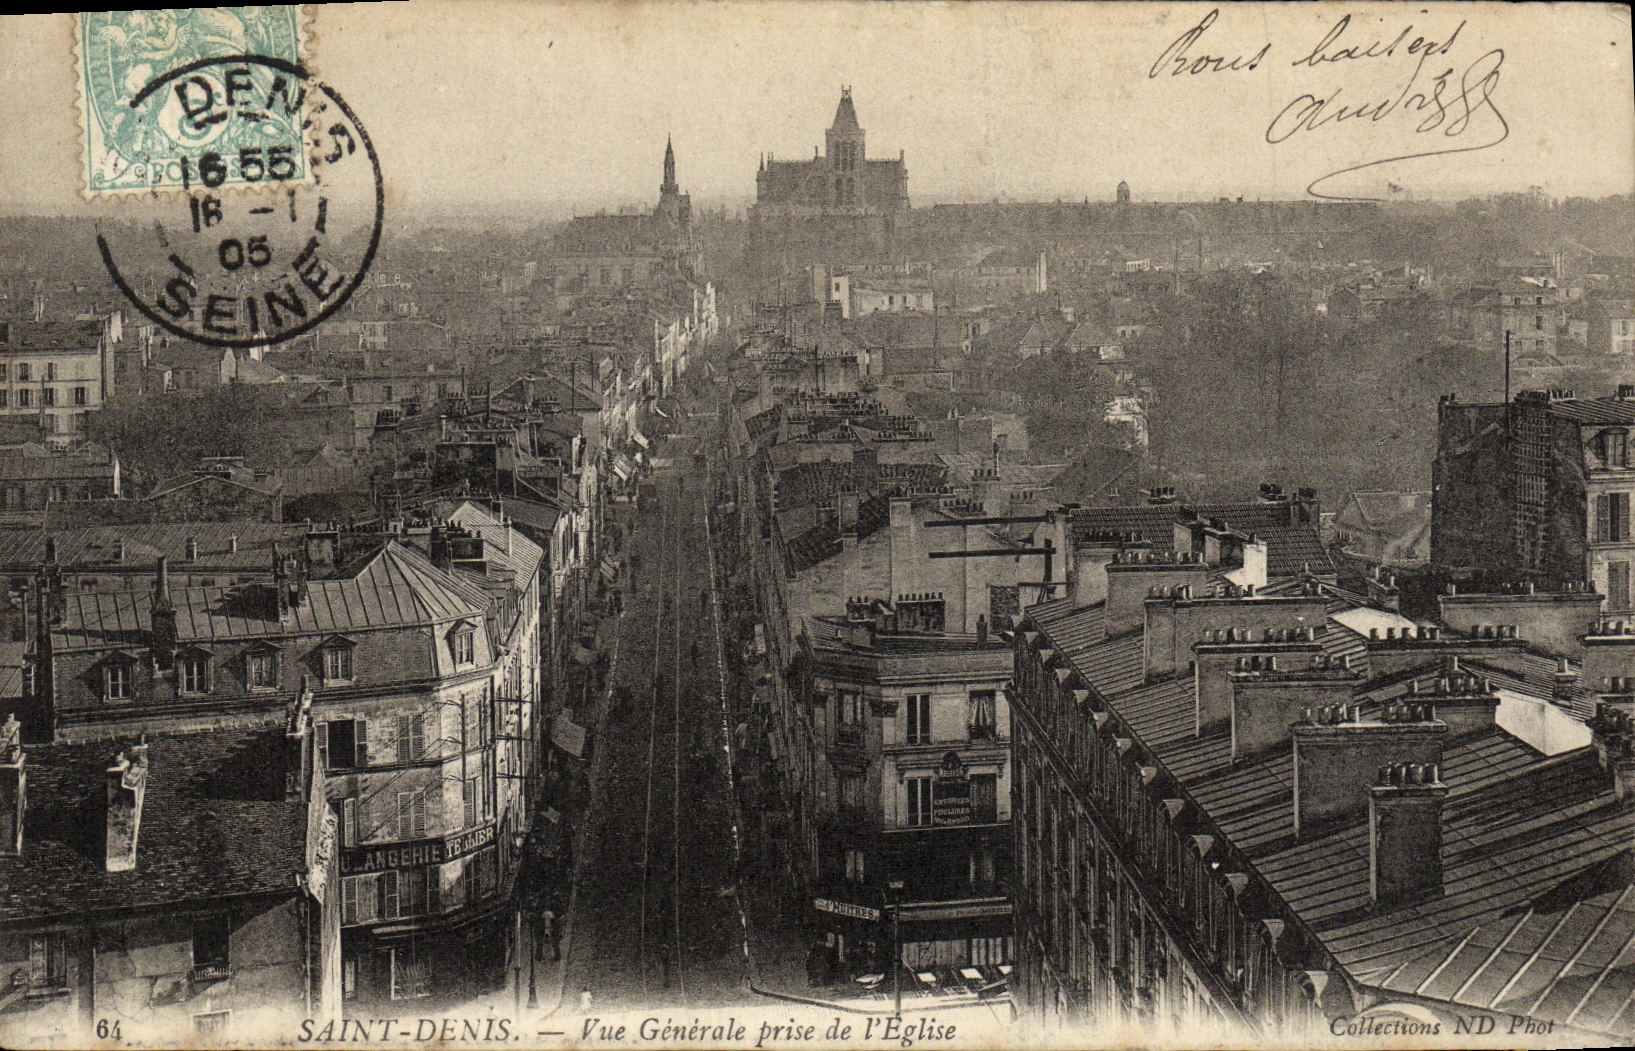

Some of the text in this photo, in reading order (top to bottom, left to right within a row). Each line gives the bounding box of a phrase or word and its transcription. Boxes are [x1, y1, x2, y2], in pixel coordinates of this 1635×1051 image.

[174, 68, 355, 165] DENS
[151, 157, 242, 183] POSS
[218, 235, 271, 271] 05
[156, 255, 345, 334] SEINE
